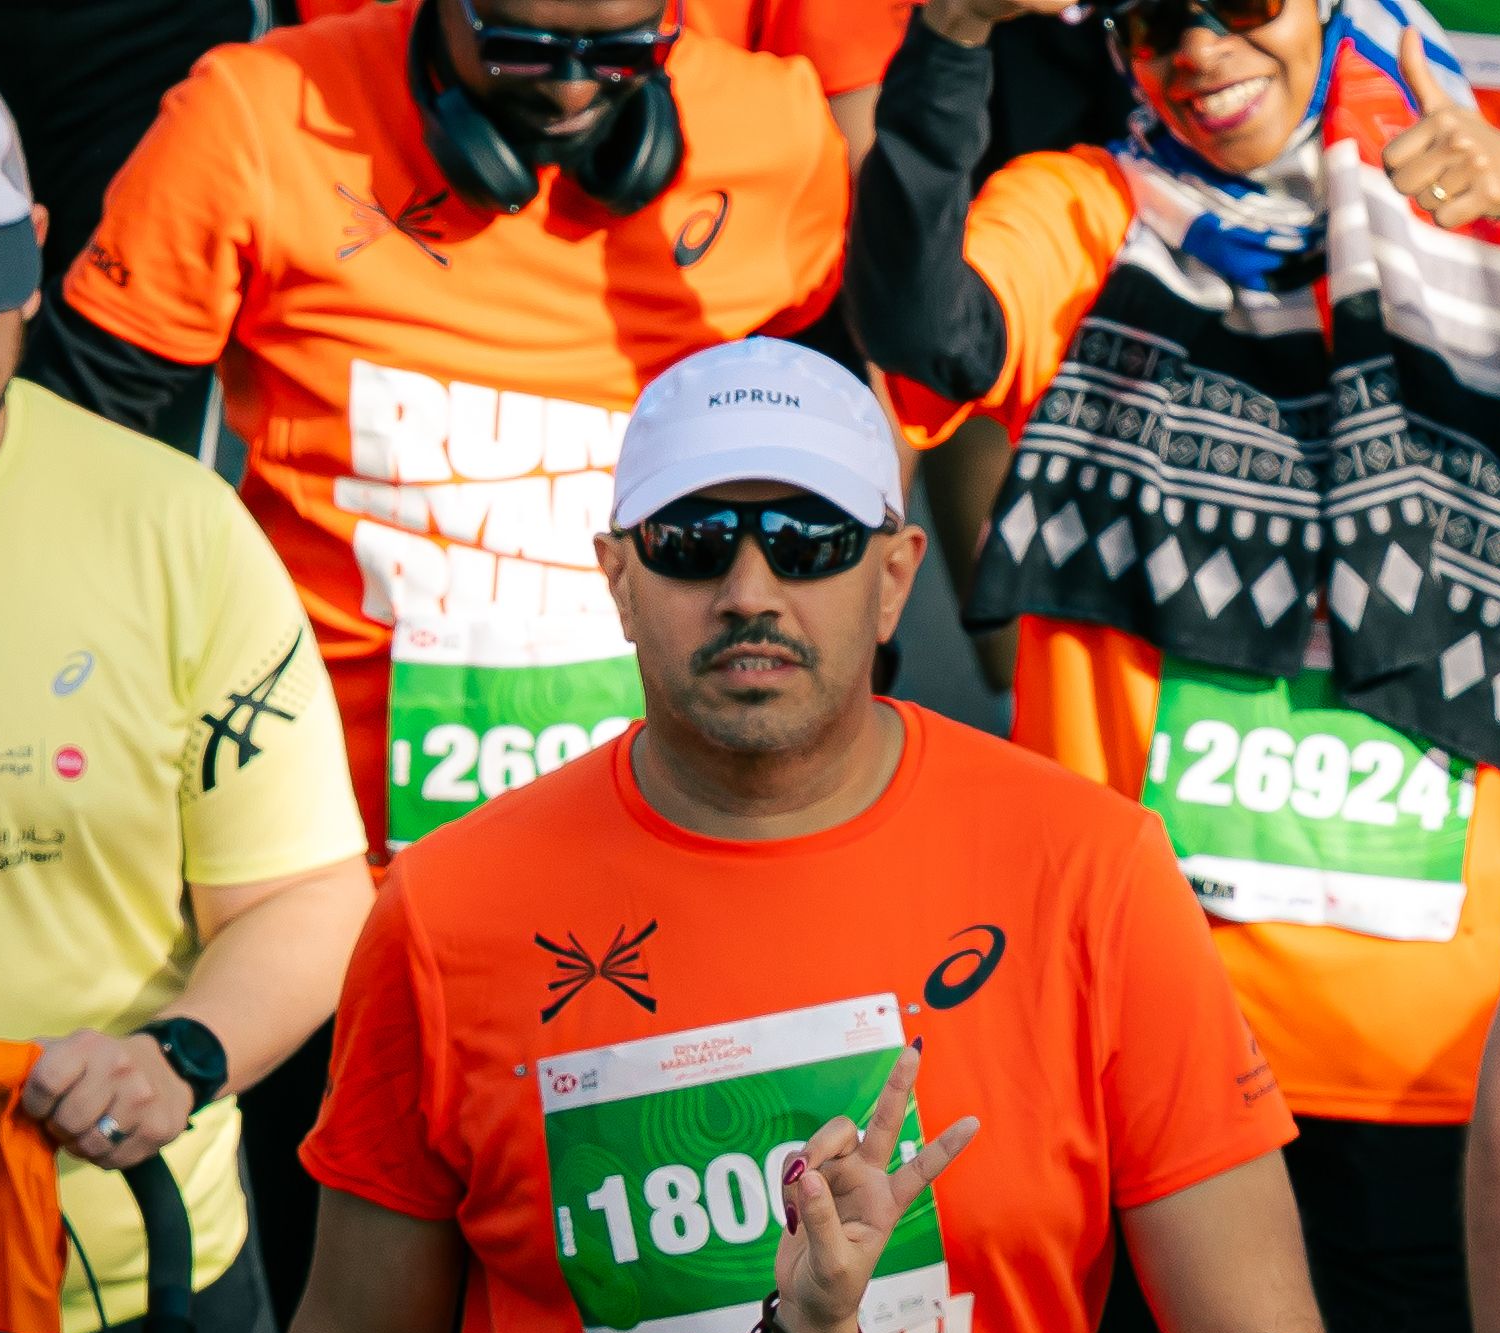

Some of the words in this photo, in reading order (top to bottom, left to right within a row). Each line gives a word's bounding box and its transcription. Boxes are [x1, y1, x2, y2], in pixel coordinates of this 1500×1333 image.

[708, 388, 802, 409] KIPRUN
[421, 717, 632, 802] 269
[1176, 720, 1452, 831] 26924
[659, 1044, 754, 1074] MARATHON
